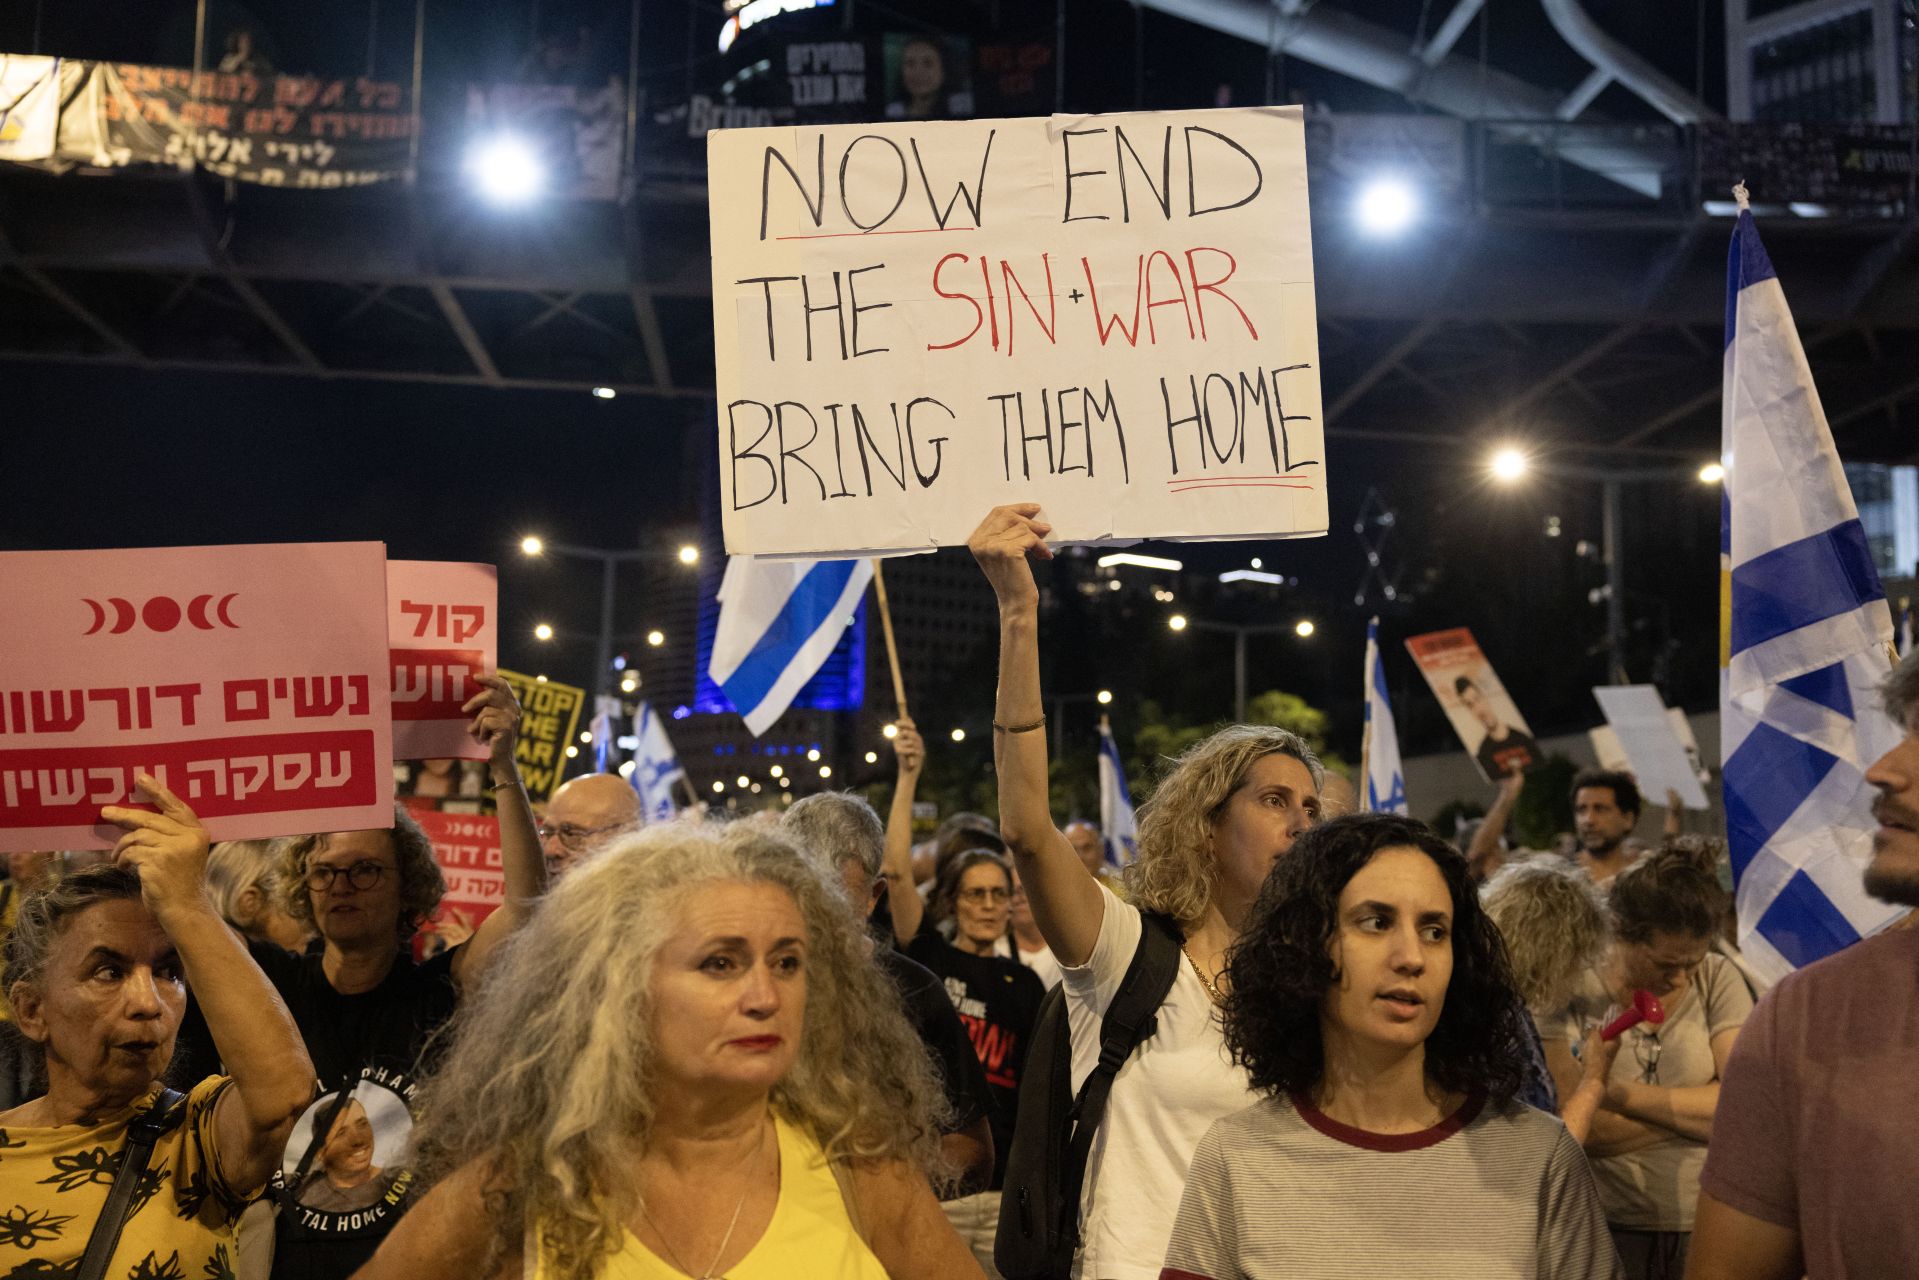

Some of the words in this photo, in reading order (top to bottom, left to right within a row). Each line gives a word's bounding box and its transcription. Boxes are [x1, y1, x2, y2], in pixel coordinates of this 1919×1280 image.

[760, 129, 996, 241] NOW
[1062, 125, 1264, 223] END
[735, 263, 893, 361] THE
[727, 397, 956, 511] BRING
[987, 379, 1130, 485] THEM
[1159, 363, 1319, 476] HOME
[400, 599, 485, 644] קול
[0, 682, 202, 735] דורשו
[223, 674, 370, 723] נשים
[514, 738, 554, 767] AR
[519, 711, 559, 743] HE
[186, 750, 352, 801] עסקה
[301, 1209, 328, 1231] TAL
[337, 1206, 386, 1232] HOME
[384, 1170, 413, 1206] NOW
